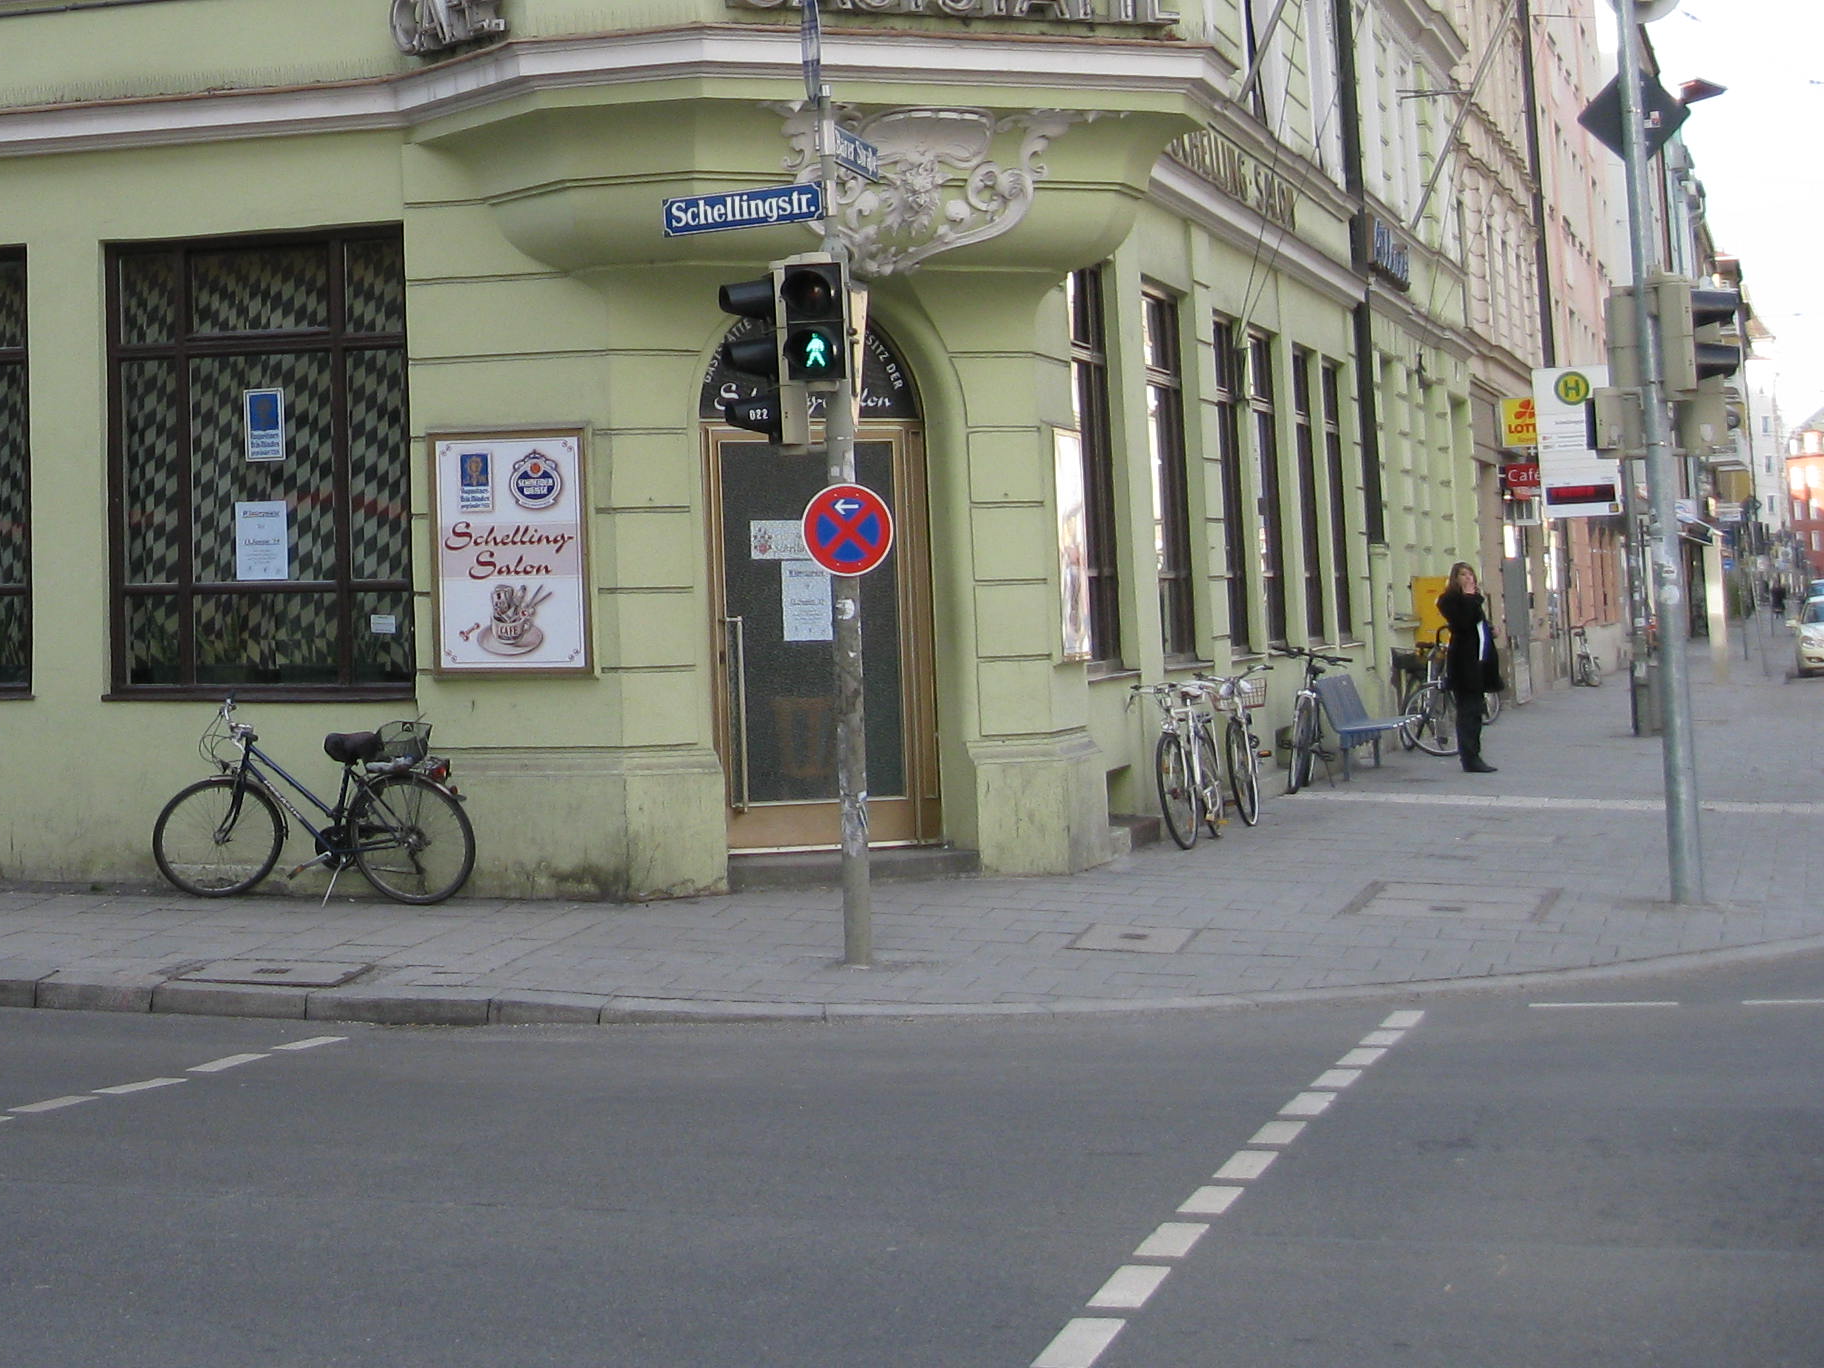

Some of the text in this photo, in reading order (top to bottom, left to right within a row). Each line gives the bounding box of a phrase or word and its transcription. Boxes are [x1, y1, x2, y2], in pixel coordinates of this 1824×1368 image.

[671, 190, 816, 228] Schellingstr.
[885, 363, 904, 390] DER
[444, 521, 574, 554] Schelling-
[468, 549, 552, 580] Salon
